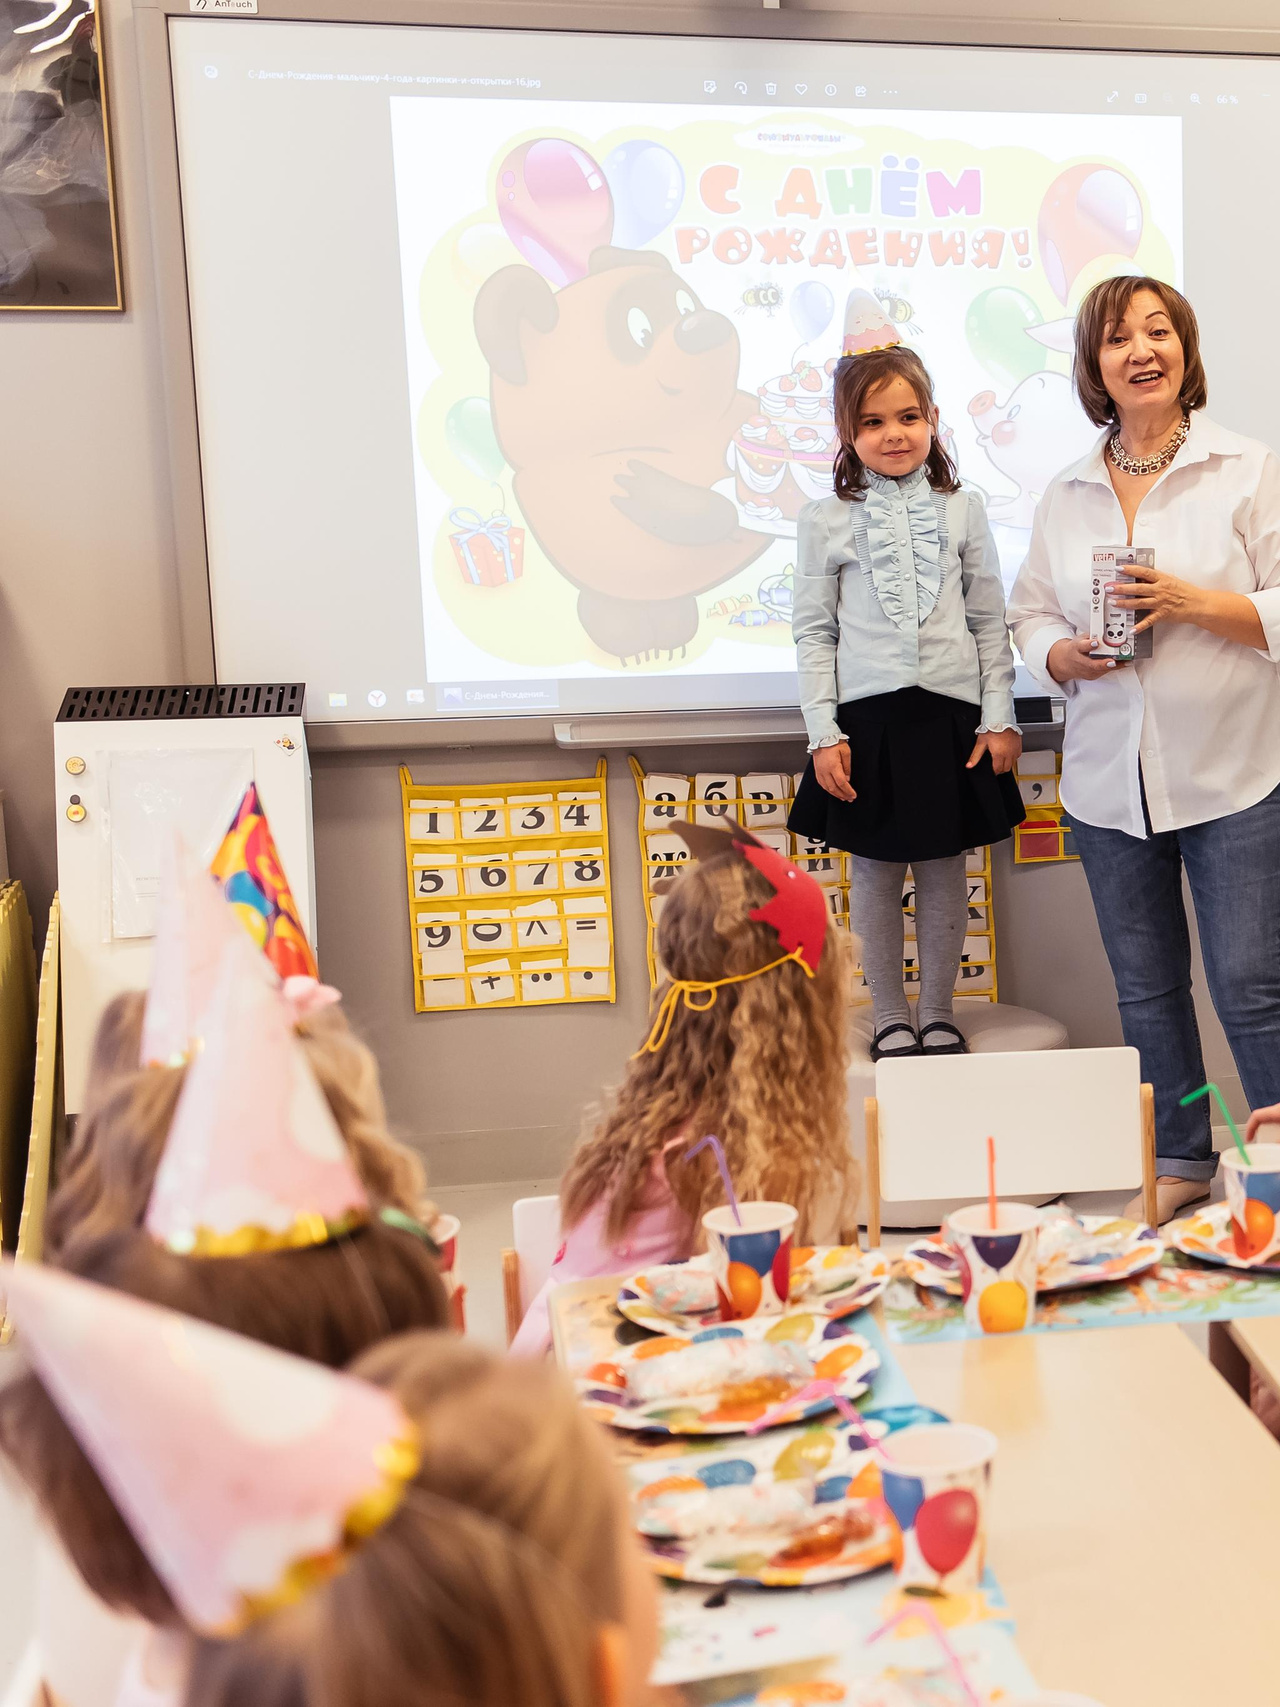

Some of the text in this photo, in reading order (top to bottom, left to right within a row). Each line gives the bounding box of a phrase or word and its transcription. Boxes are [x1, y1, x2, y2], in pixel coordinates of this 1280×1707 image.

[1217, 95, 1228, 104] 66
[700, 155, 981, 219] С ДНЁМ
[675, 226, 1032, 269] РОЖДЕНИЯ!
[426, 797, 589, 834] 1 2 3 4
[653, 781, 777, 817] а б в
[419, 854, 601, 893] 5 6 7 8
[424, 920, 450, 948] 9
